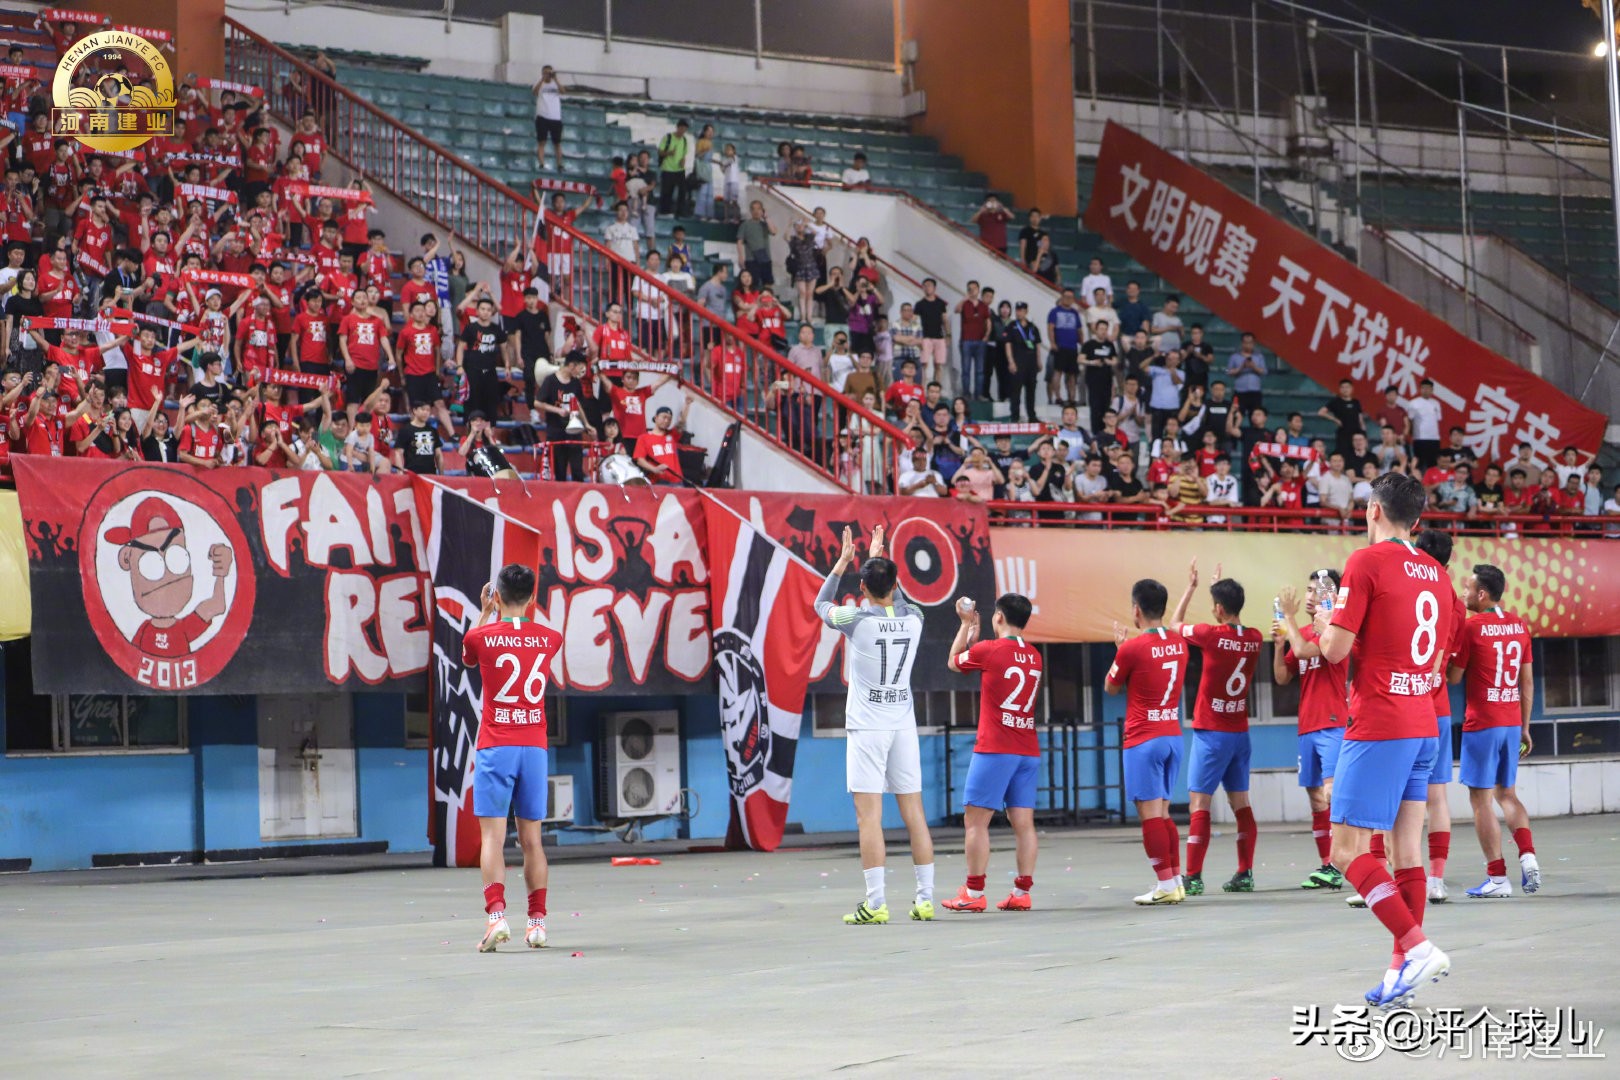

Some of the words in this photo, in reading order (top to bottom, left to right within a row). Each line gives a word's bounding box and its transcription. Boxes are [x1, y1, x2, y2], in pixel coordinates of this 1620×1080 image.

[1110, 162, 1258, 300] 文明观赛
[1262, 255, 1561, 474] 天下球迷一家亲
[552, 490, 614, 581] IS
[647, 493, 706, 583] A
[1404, 561, 1439, 582] CHOW
[484, 635, 521, 647] WANG
[524, 636, 552, 647] SH.Y.
[878, 622, 896, 632] WU
[1217, 637, 1241, 651] FENG
[1411, 590, 1439, 665] 8
[137, 656, 197, 688] 2013
[875, 638, 911, 685] 17
[1014, 652, 1026, 664] LU
[1151, 646, 1164, 658] DU
[1493, 640, 1521, 687] 13
[493, 653, 547, 704] 26
[1000, 666, 1042, 713] 27
[1160, 660, 1178, 706] 7
[1225, 657, 1247, 697] 6
